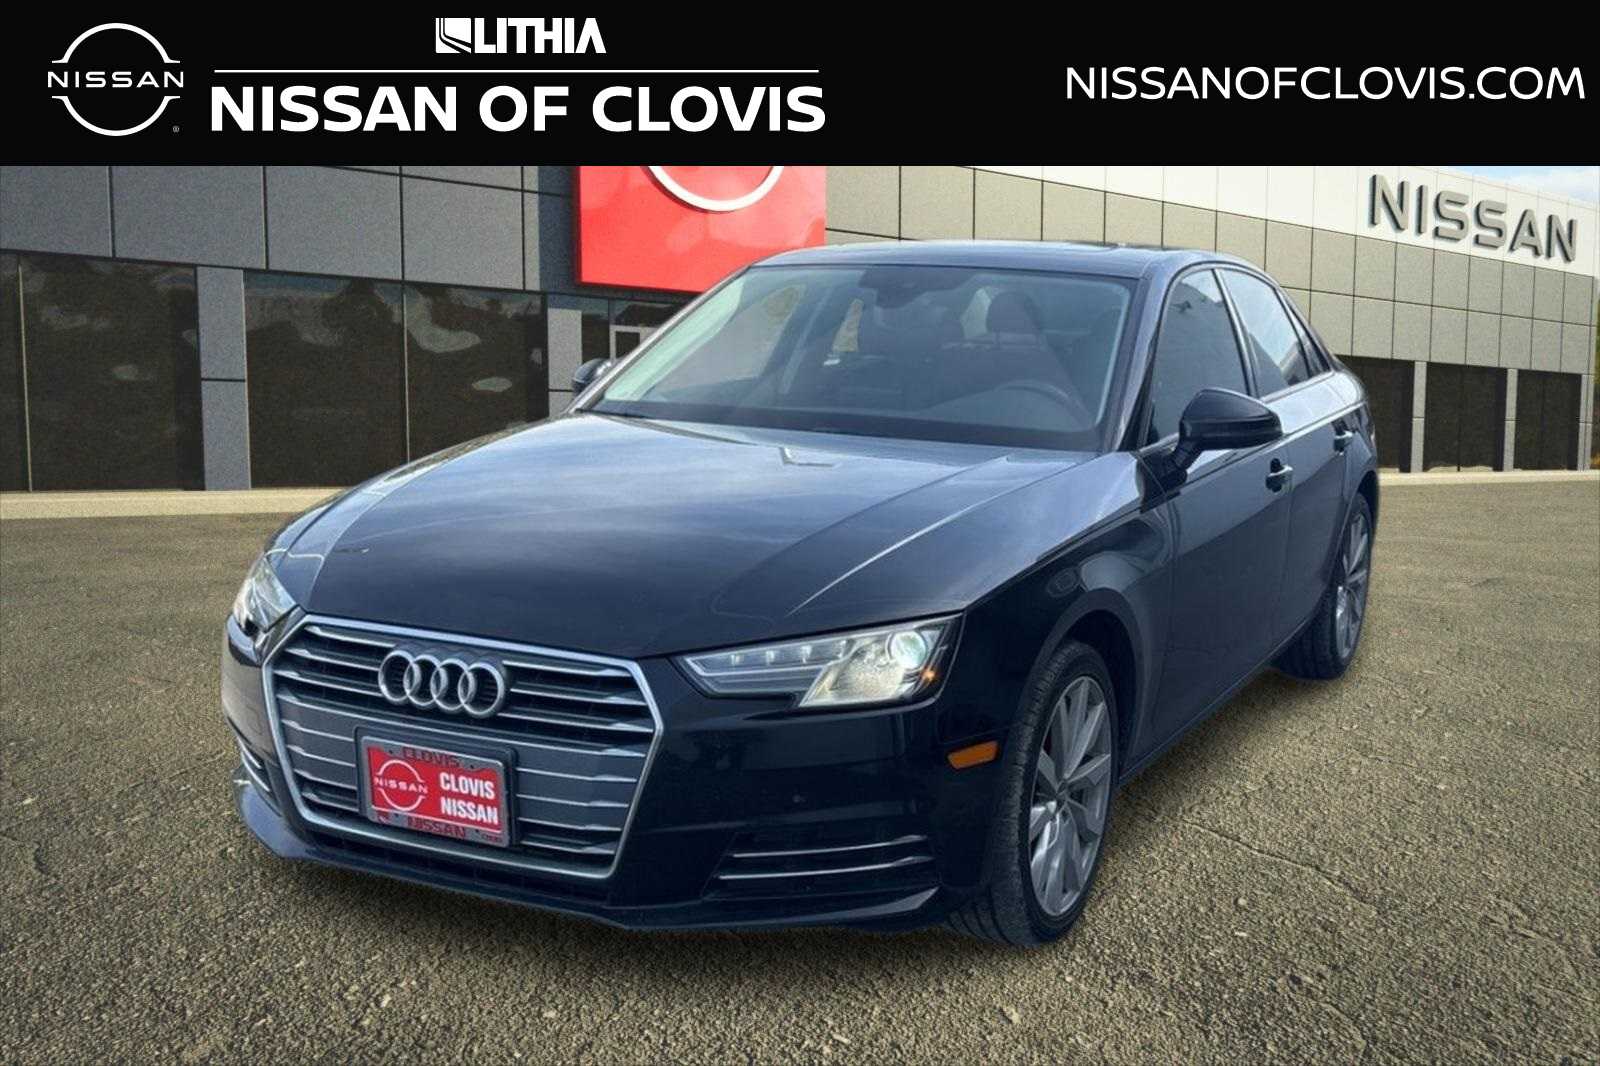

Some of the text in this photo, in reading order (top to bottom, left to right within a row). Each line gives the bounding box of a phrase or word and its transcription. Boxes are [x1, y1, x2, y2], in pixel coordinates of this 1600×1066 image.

[1369, 174, 1578, 263] NISSAN
[373, 777, 429, 794] NISSAN
[439, 772, 496, 800] CLOVIS
[440, 797, 499, 825] NISSAN
